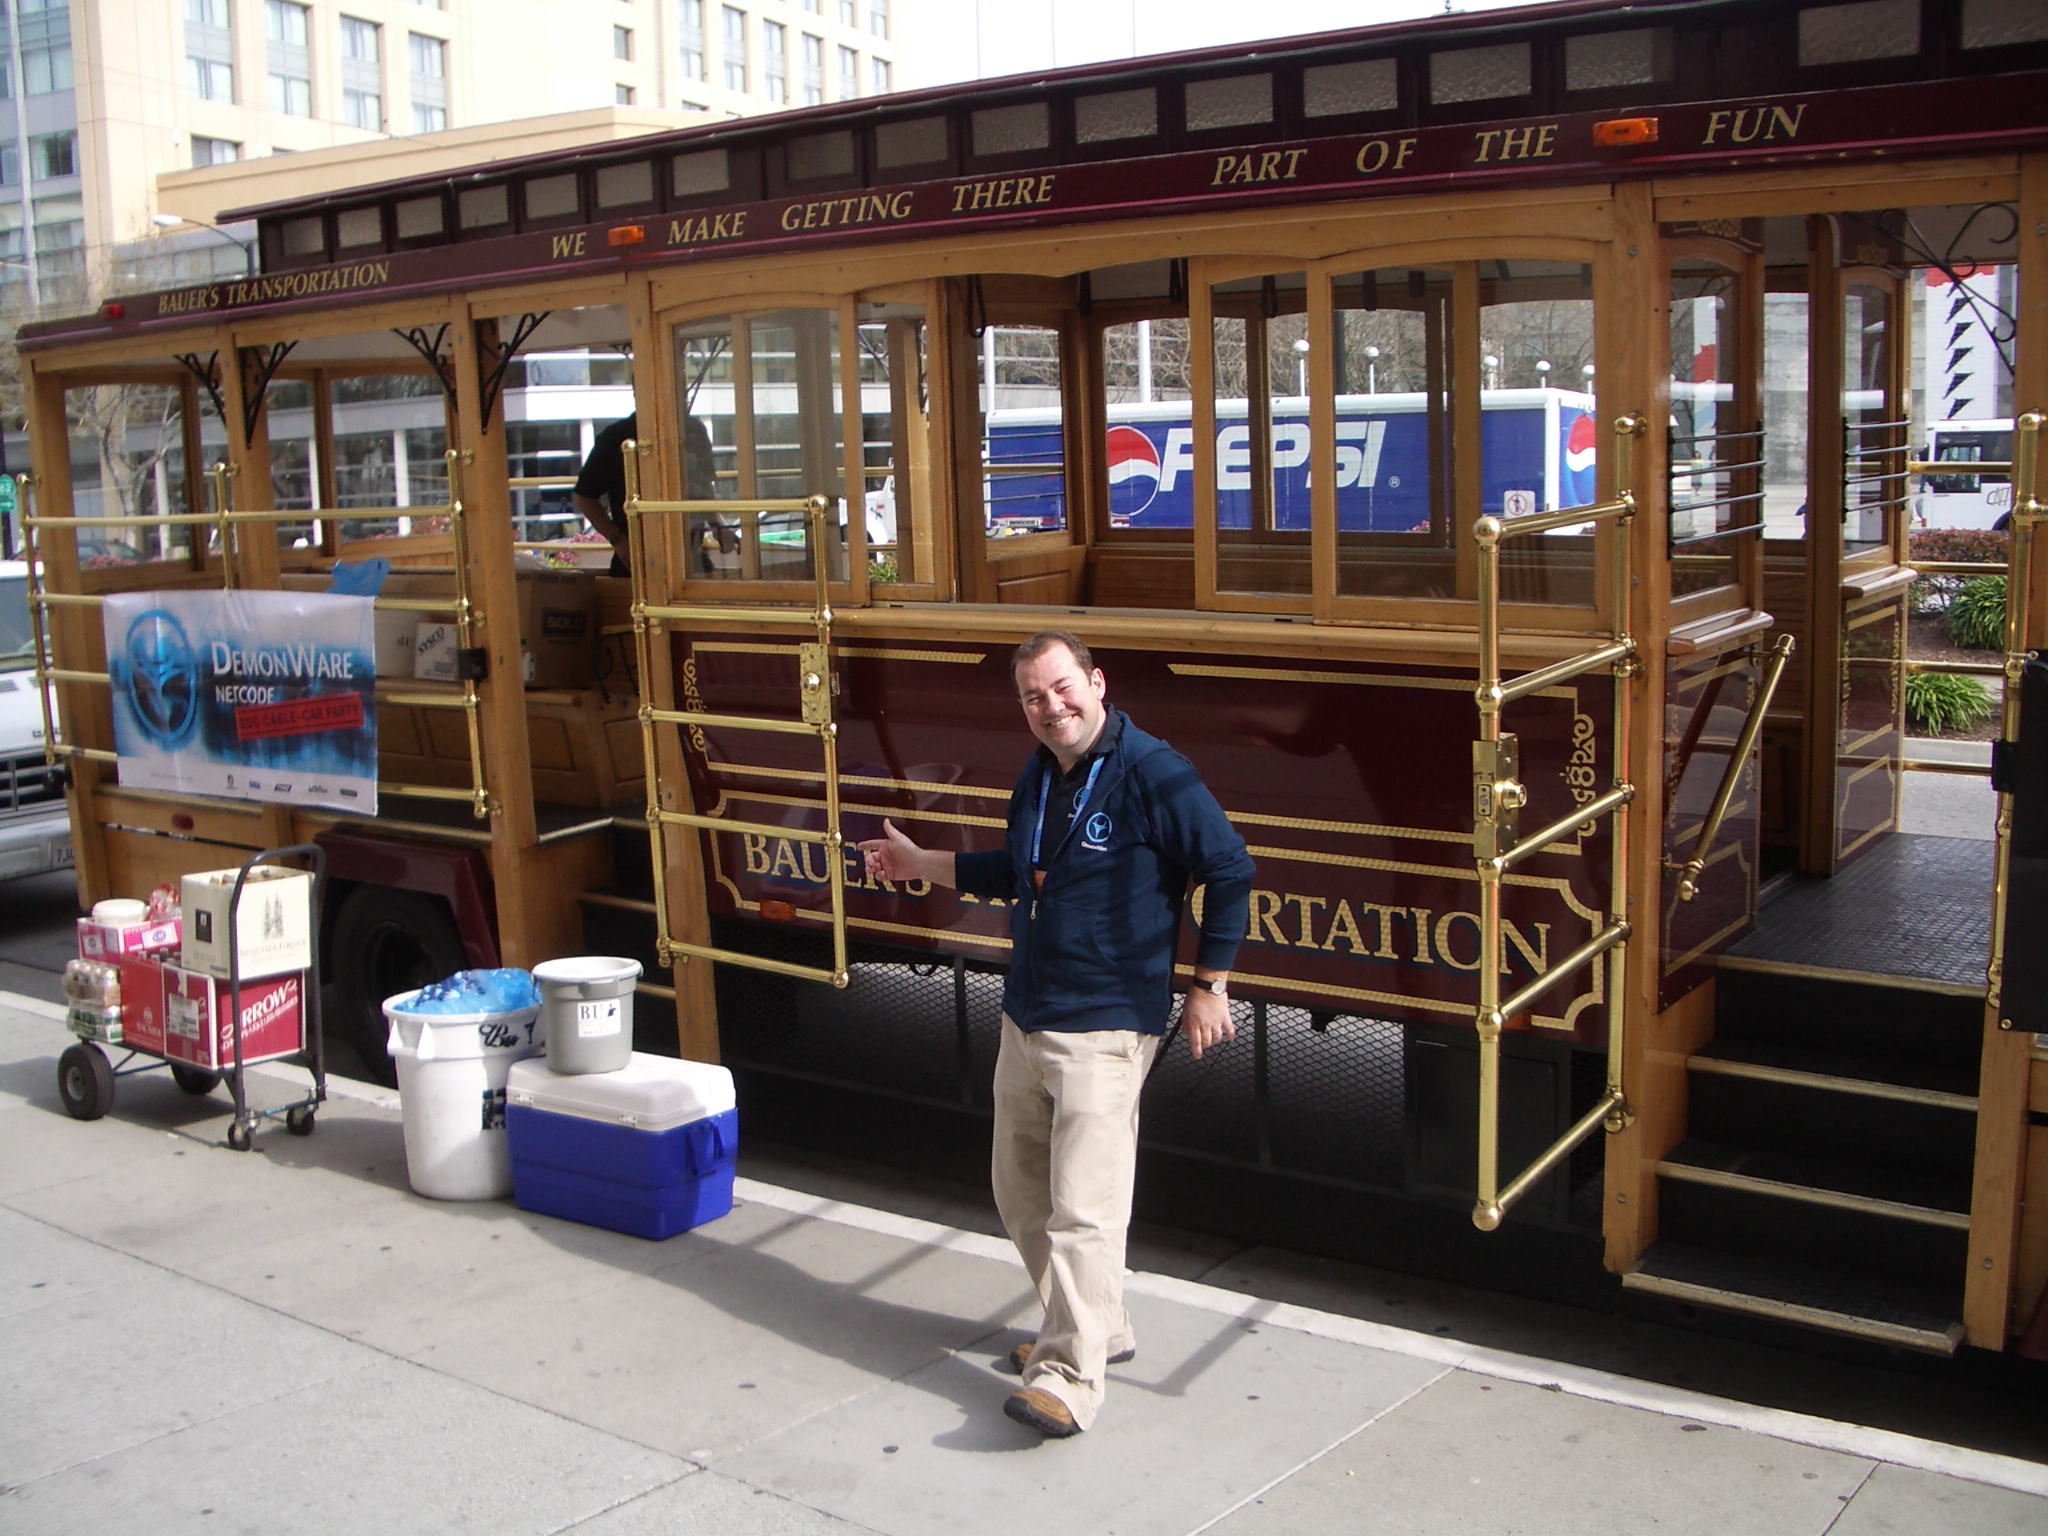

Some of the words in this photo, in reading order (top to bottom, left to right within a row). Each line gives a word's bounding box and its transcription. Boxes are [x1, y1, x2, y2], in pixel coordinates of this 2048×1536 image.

[552, 231, 588, 259] WE
[667, 211, 747, 245] MAKE
[781, 190, 914, 231] GETTING
[951, 174, 1056, 212] THERE
[1211, 148, 1309, 187] PART
[1355, 138, 1418, 174] OF
[1473, 123, 1559, 163] THE
[1701, 103, 1808, 145] FUN
[159, 285, 219, 315] BAUER'S
[226, 261, 390, 306] TRANSPORTATION
[1158, 420, 1388, 493] PEPSI
[417, 626, 446, 657] SYSCO
[325, 703, 359, 718] PARTY
